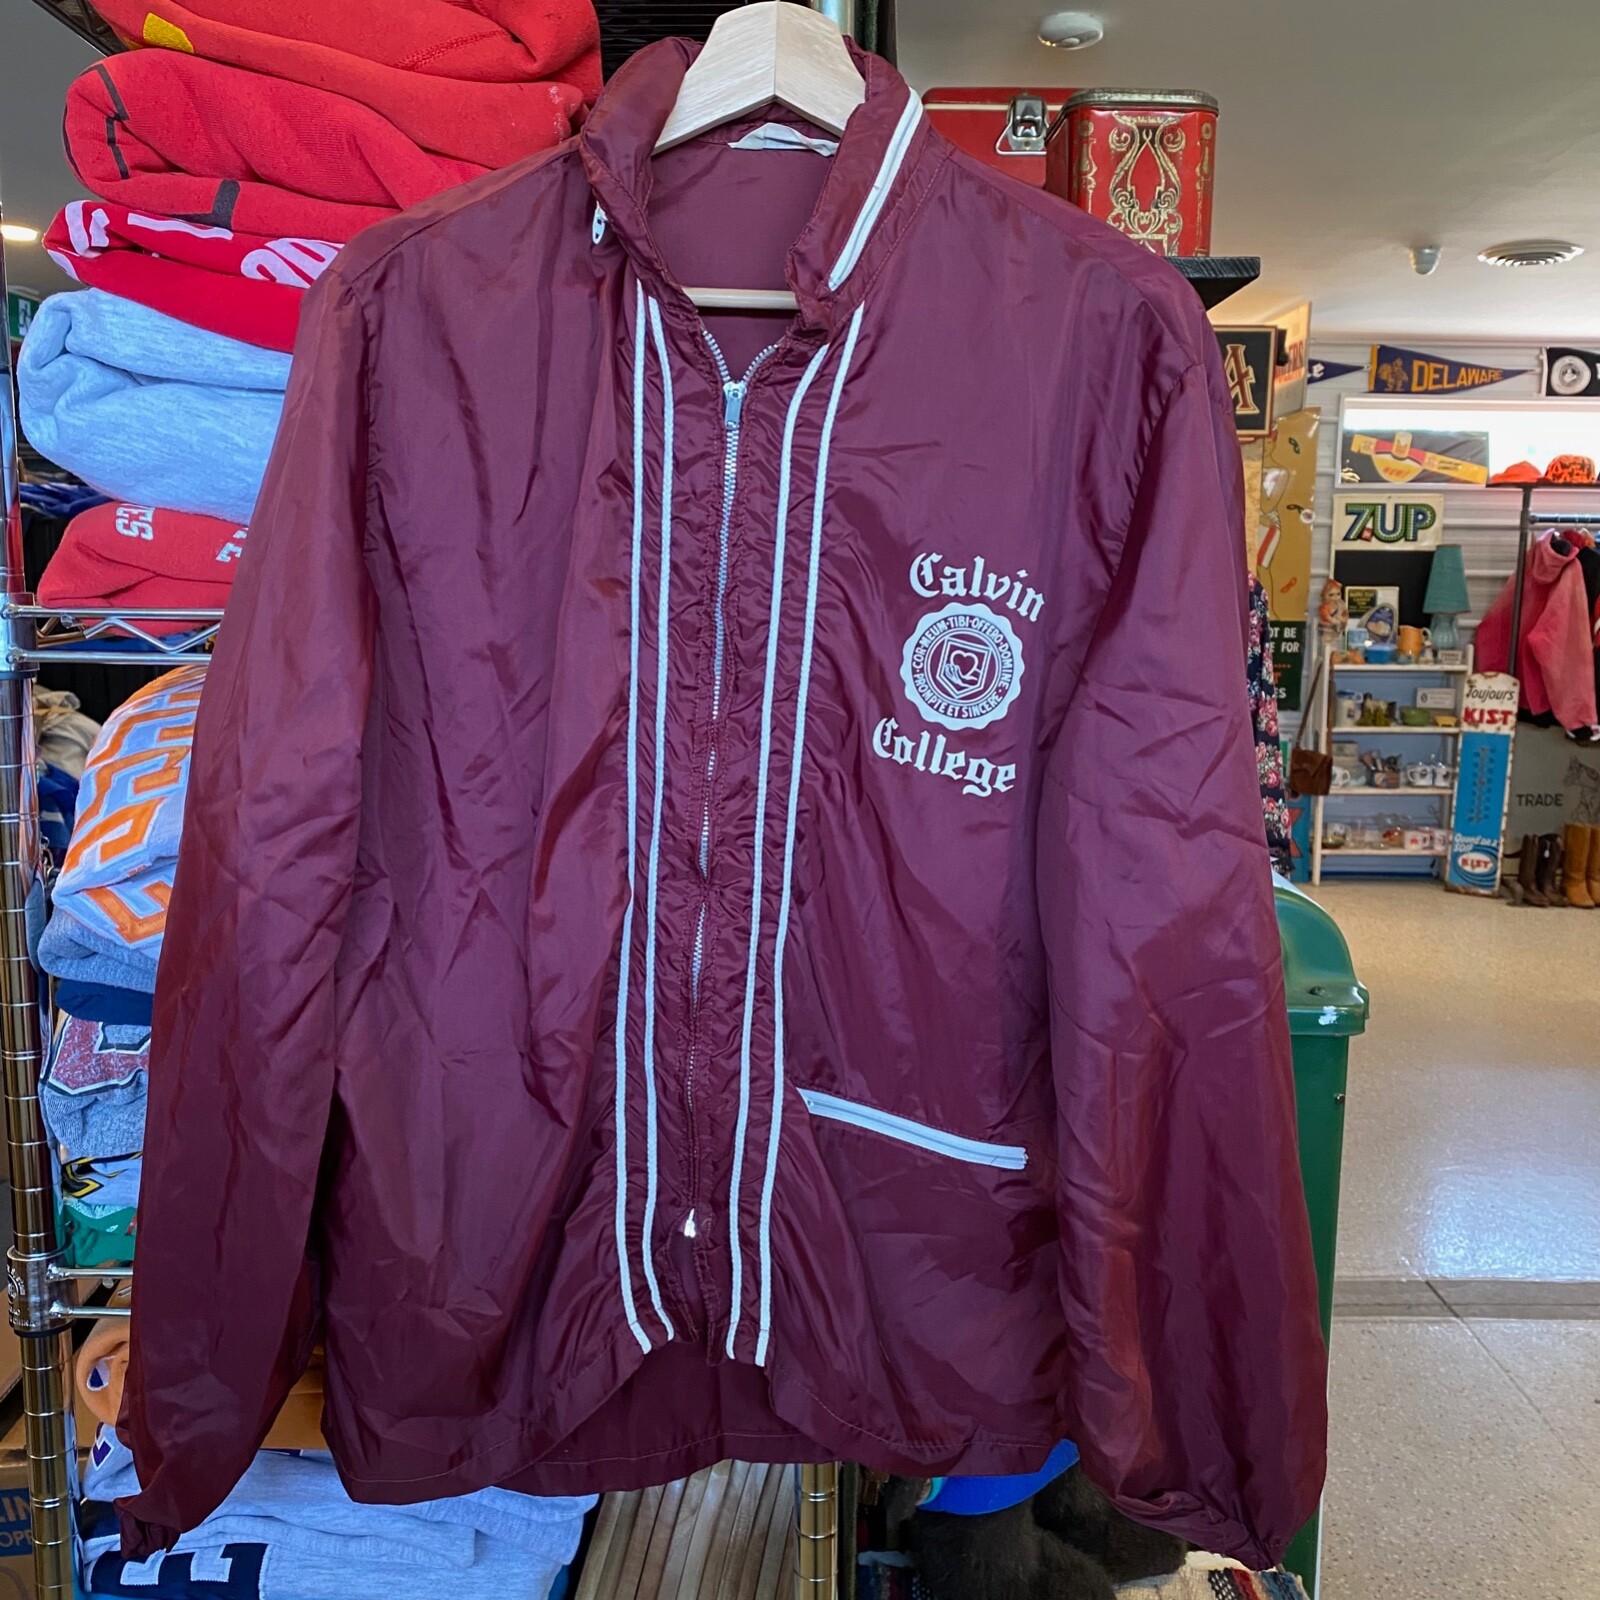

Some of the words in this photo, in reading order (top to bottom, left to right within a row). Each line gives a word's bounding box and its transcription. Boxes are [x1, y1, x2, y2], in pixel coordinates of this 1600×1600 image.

[1411, 359, 1503, 392] DELAWARE
[909, 552, 1045, 622] Calvin
[1284, 627, 1297, 638] BE
[912, 647, 926, 669] COR
[919, 620, 948, 648] MEUM
[948, 615, 969, 629] TIBI
[972, 617, 1003, 643] OFFERO
[999, 643, 1013, 690] DOMINE
[1281, 641, 1300, 653] FOR
[913, 673, 946, 713] PROMPTE
[947, 705, 960, 717] ET
[961, 691, 1003, 718] SINCERE
[1466, 685, 1515, 703] Toujours
[1464, 707, 1513, 725] KIST
[872, 717, 1017, 797] College
[1516, 793, 1563, 807] TRADE
